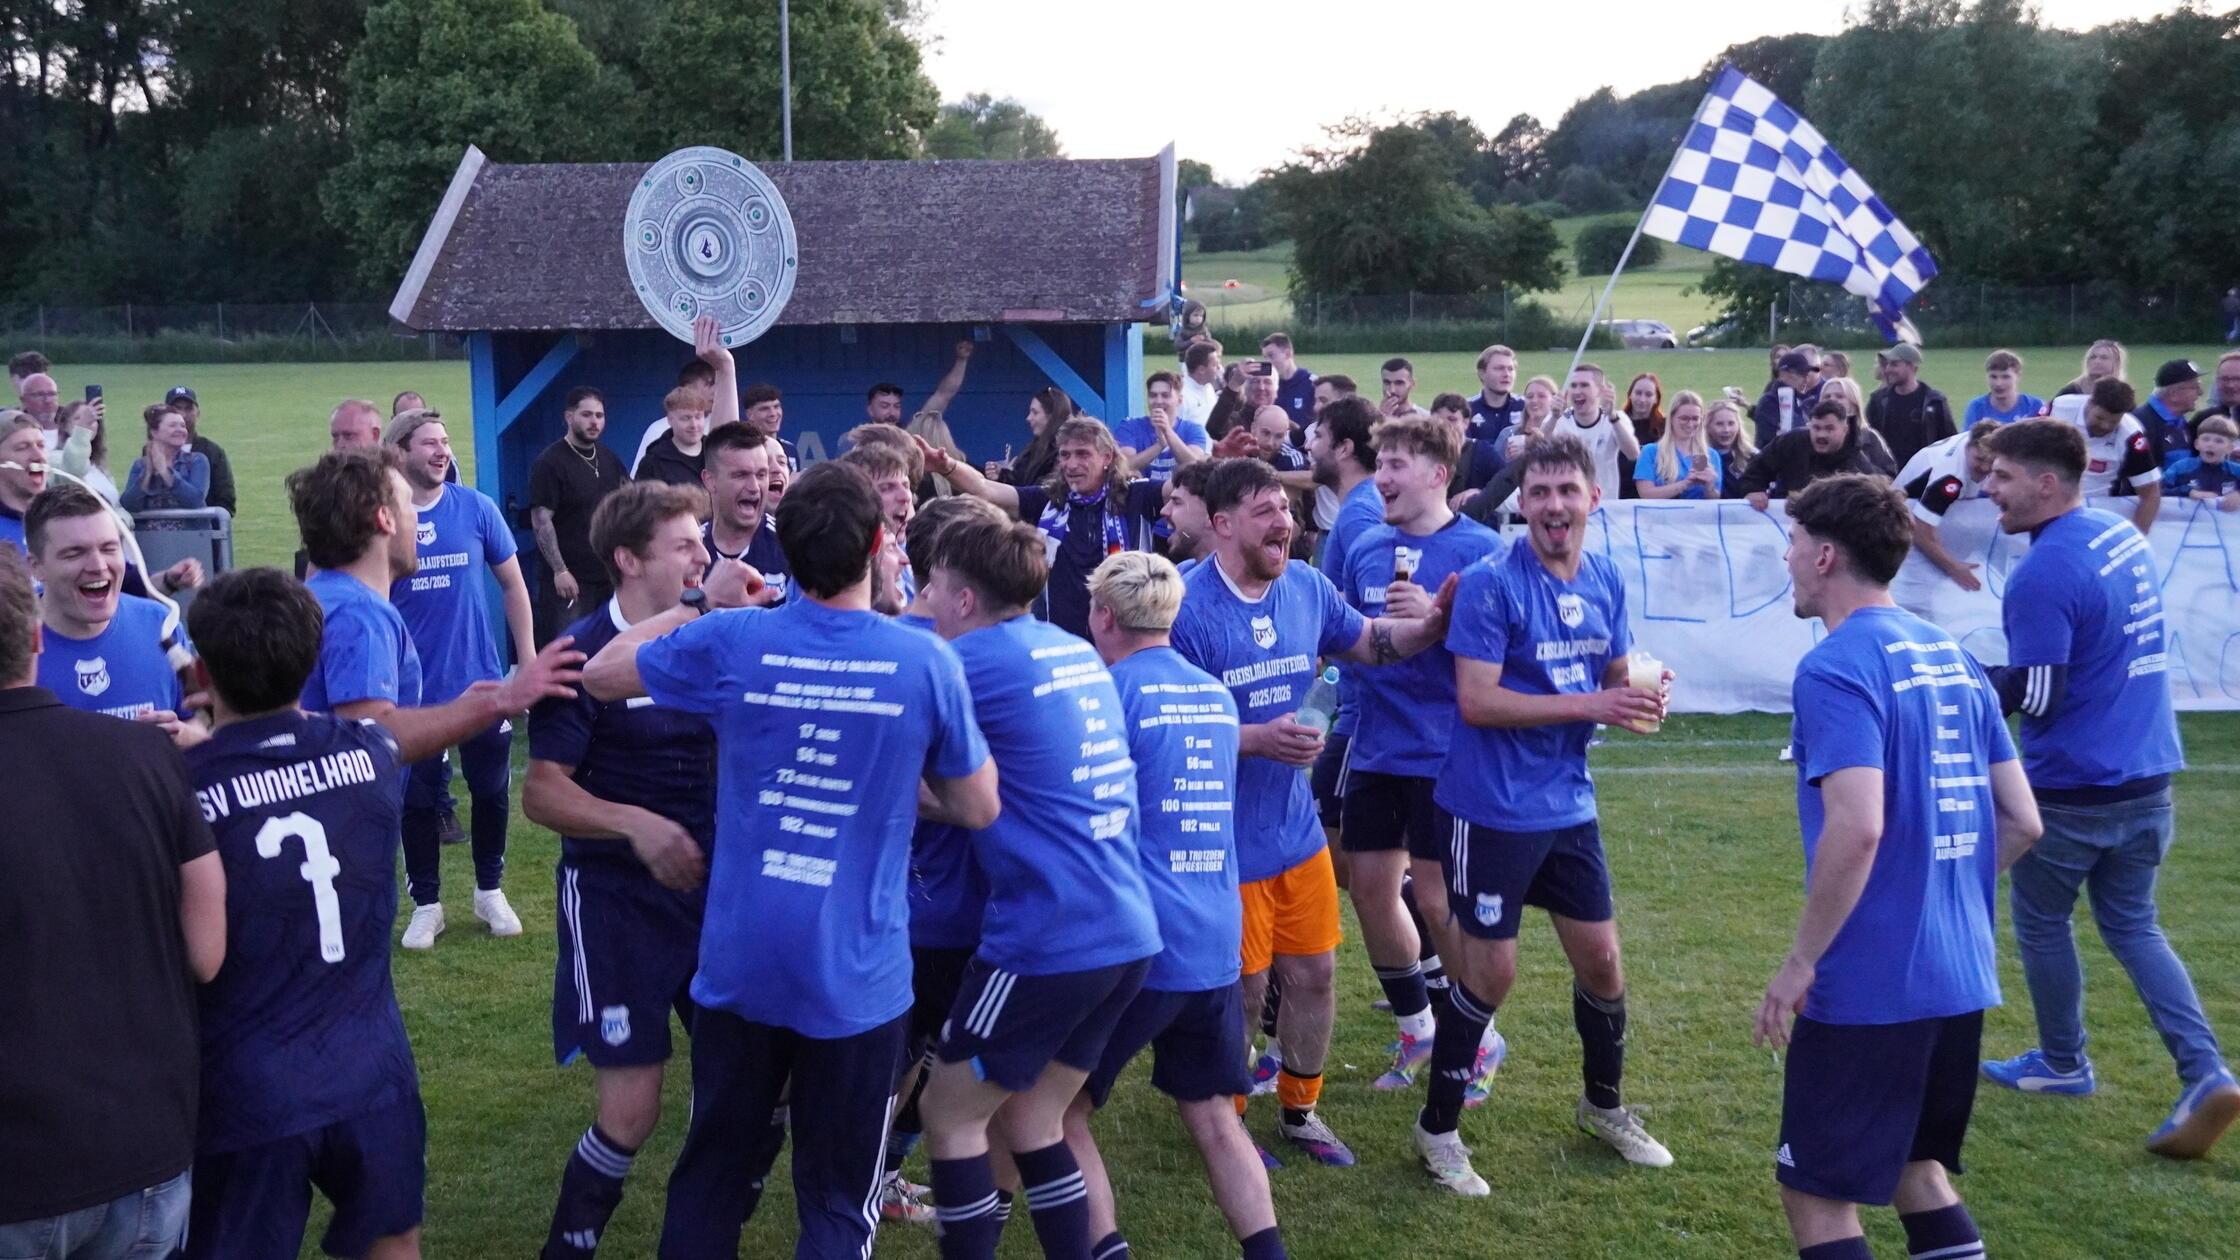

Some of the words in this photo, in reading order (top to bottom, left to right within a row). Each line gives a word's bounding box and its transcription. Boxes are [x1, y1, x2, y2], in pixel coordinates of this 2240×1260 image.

[411, 574, 451, 591] 2025/2026
[1222, 654, 1310, 688] KREISLIGAAUFSTEIGER
[1249, 684, 1291, 708] 2025/2026
[1184, 735, 1195, 749] 17
[231, 748, 377, 809] WINKELHAID
[1173, 777, 1187, 791] 73
[1161, 798, 1180, 812] 100
[1180, 819, 1198, 832] 182
[1169, 850, 1187, 862] UND
[1188, 849, 1225, 861] TROTZDEM
[1171, 860, 1223, 873] AUFGESTIEGEN
[255, 811, 346, 963] 7
